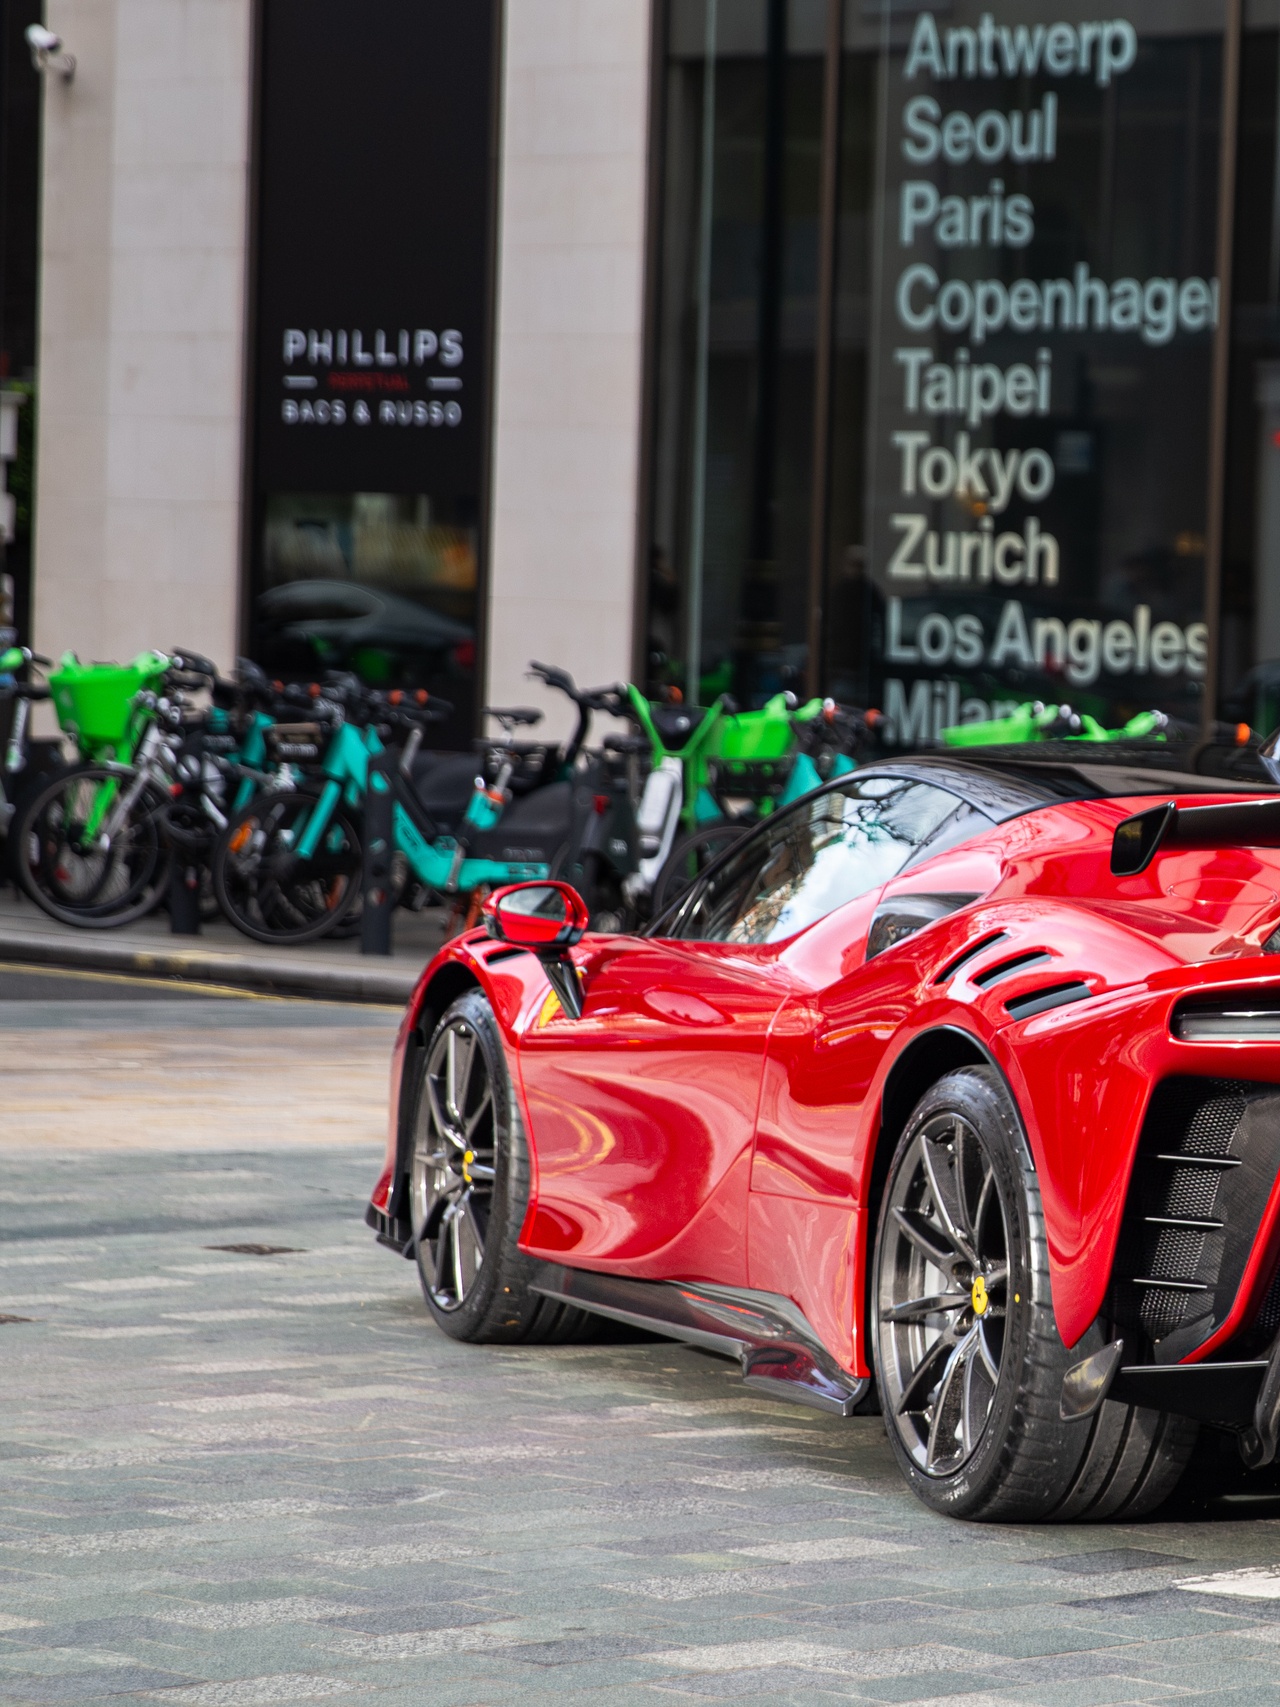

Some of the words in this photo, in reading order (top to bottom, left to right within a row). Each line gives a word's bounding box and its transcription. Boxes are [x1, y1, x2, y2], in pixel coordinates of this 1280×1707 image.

[905, 12, 1137, 86] Antwerp
[902, 92, 1057, 163] Seoul
[899, 178, 1035, 247] Paris
[896, 262, 1219, 344] Copenhage
[283, 328, 464, 368] PHILLIPS
[352, 399, 371, 427] &
[379, 399, 462, 427] RUSSO
[894, 347, 1052, 426] Taipei
[893, 430, 1055, 509] Tokyo
[888, 515, 1059, 586] Zurich
[887, 598, 985, 665] Los
[990, 600, 1208, 685] Angeles
